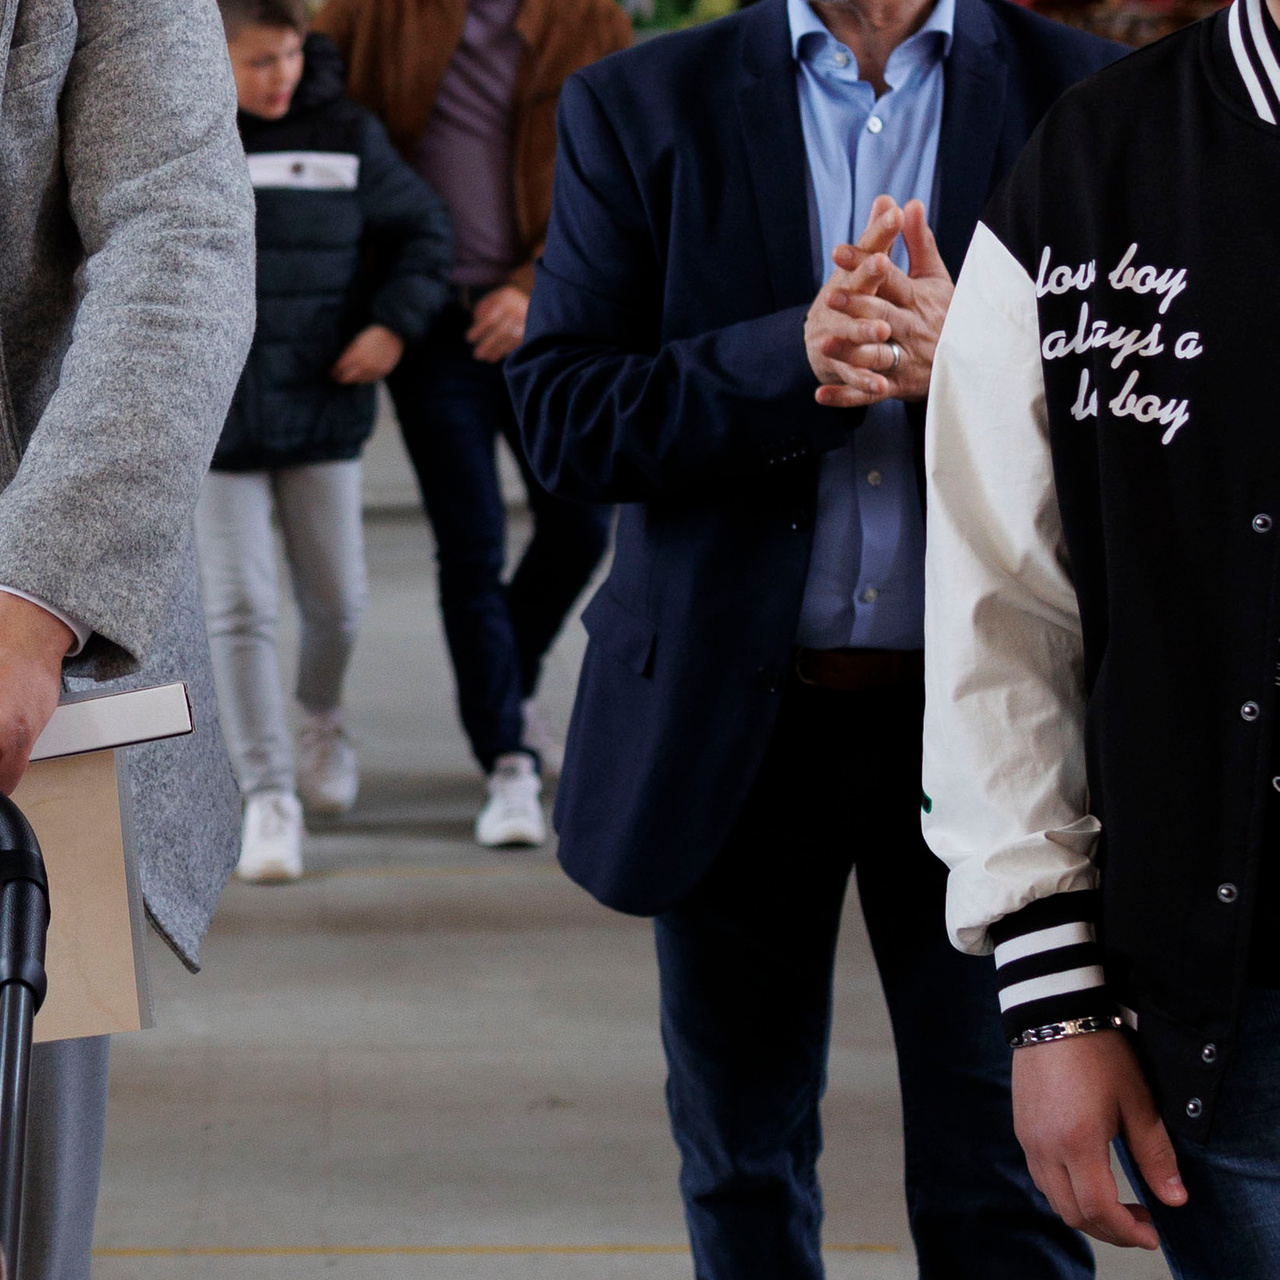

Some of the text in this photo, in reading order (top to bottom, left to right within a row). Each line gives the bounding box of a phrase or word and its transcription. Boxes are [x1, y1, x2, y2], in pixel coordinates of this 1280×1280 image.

[1108, 243, 1187, 314] boy
[1175, 332, 1203, 359] a
[1108, 370, 1189, 445] boy
